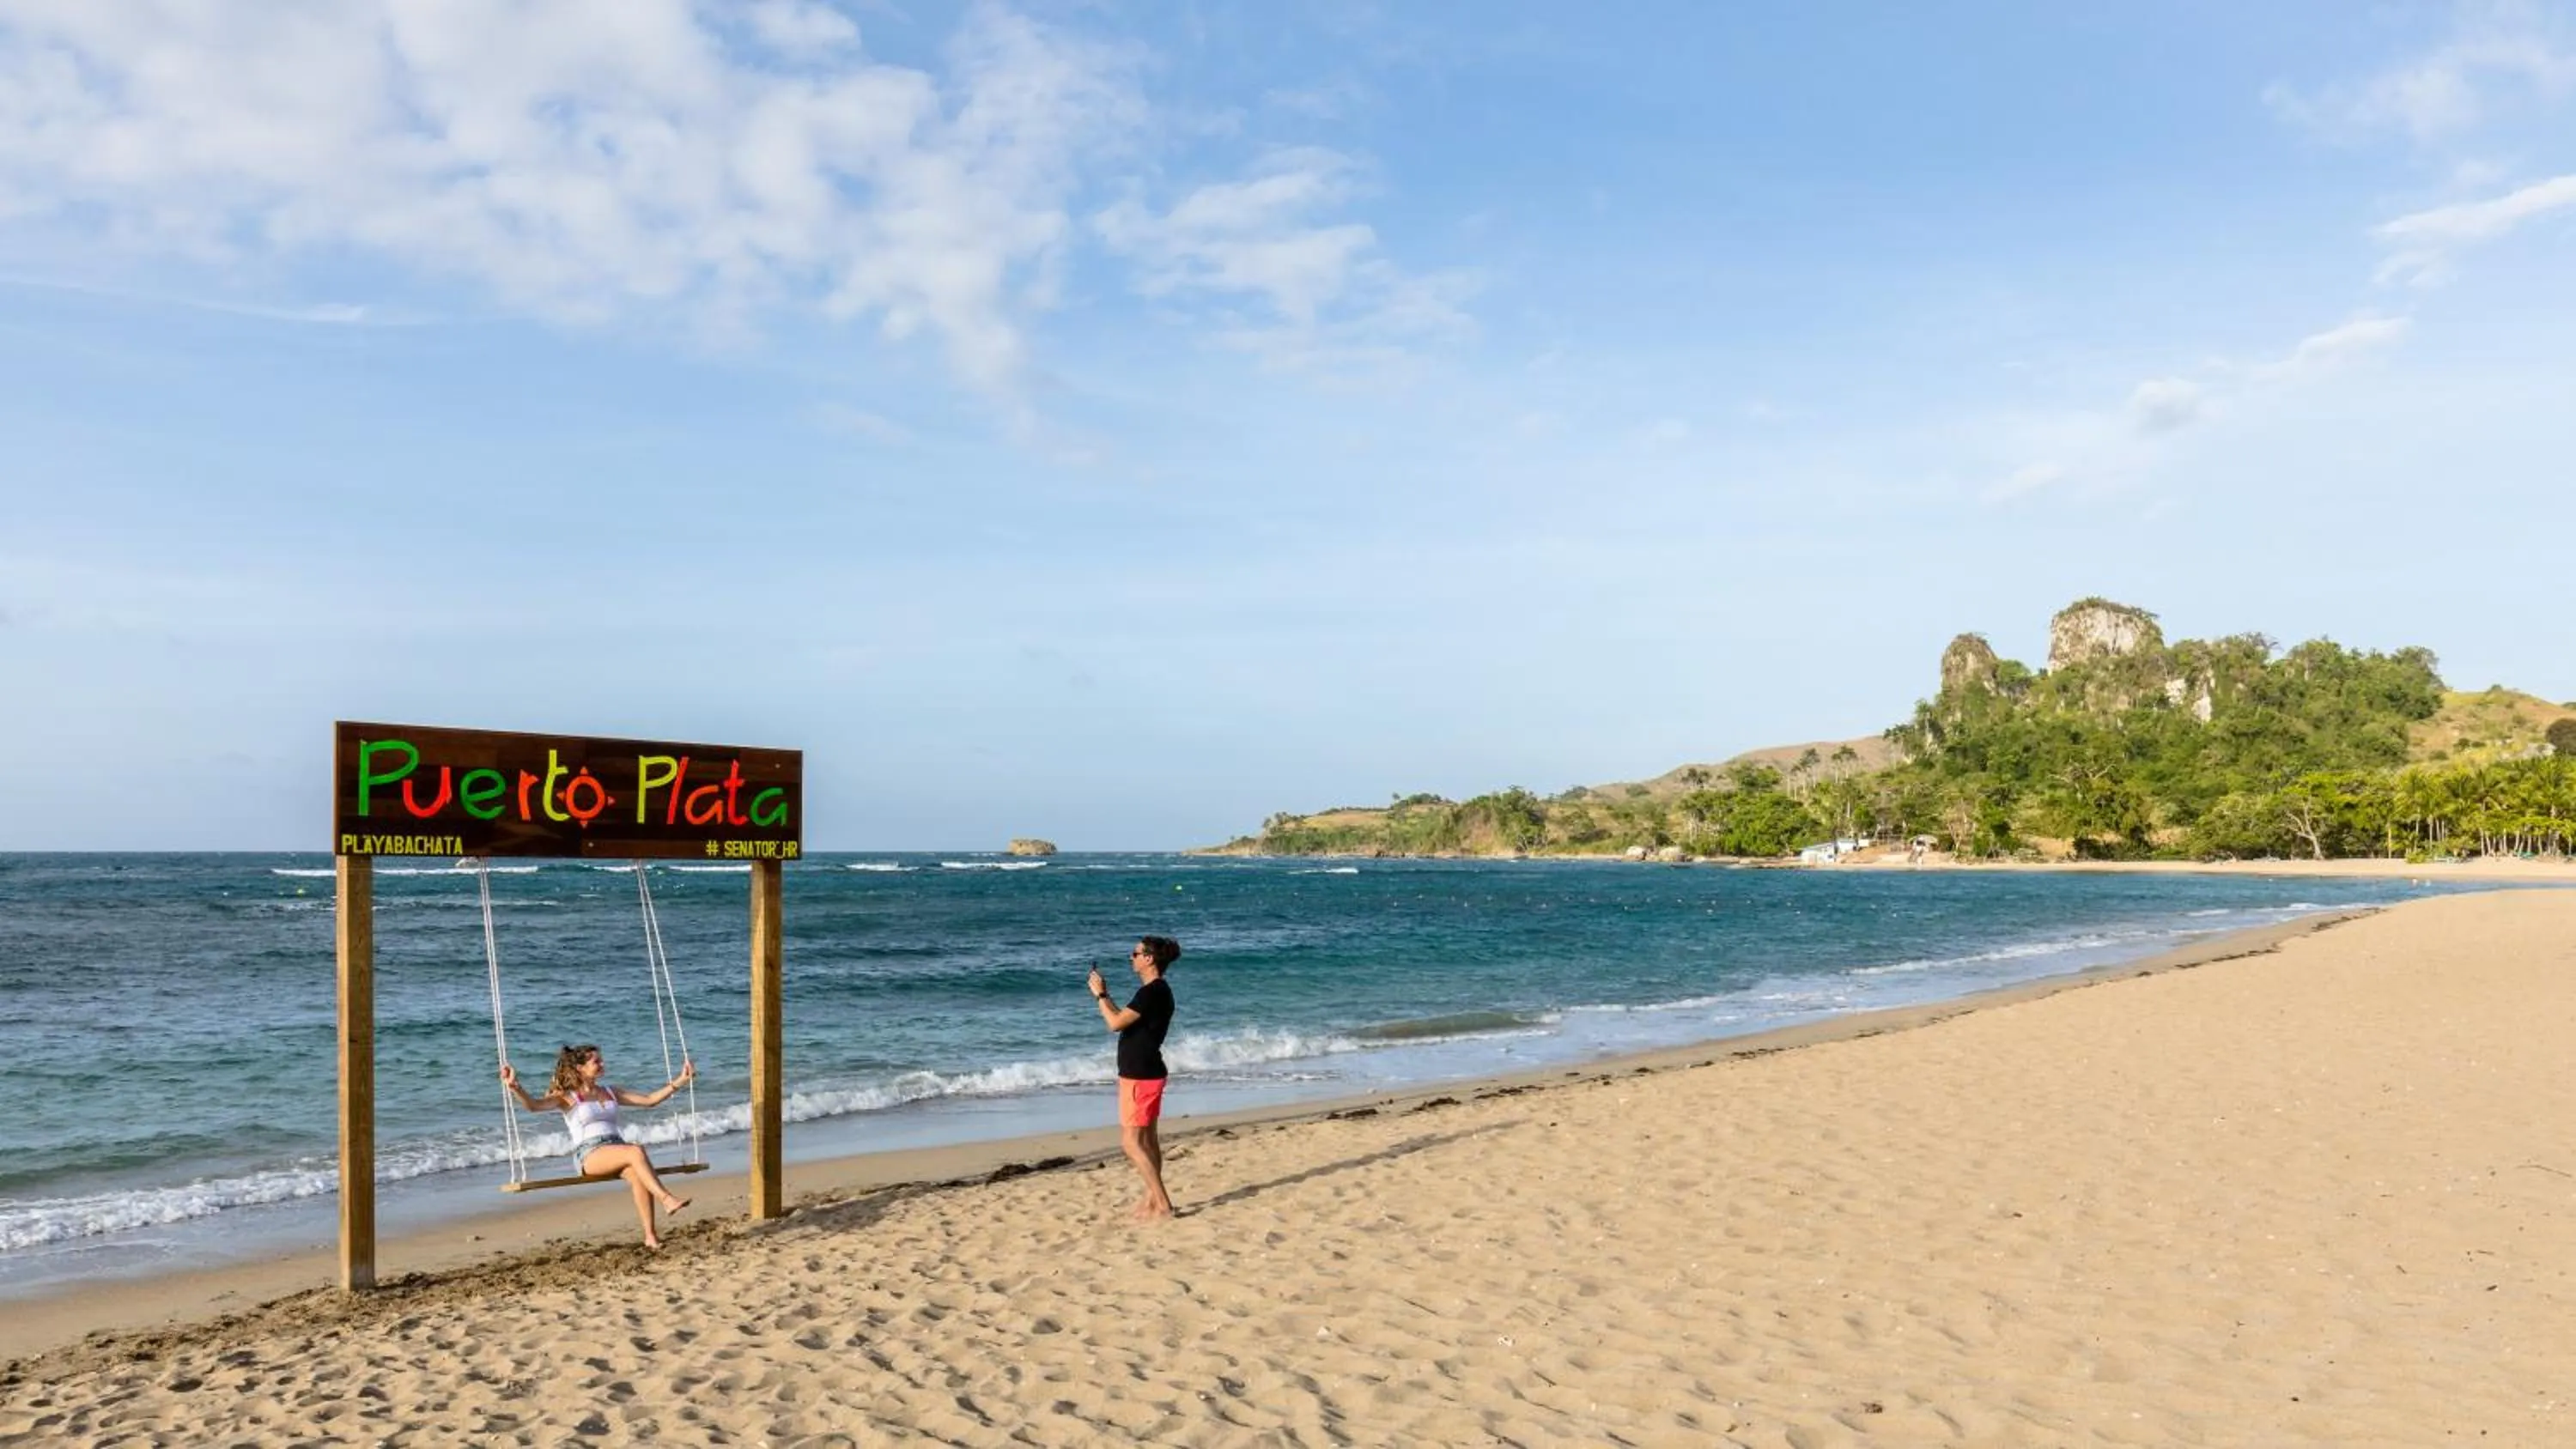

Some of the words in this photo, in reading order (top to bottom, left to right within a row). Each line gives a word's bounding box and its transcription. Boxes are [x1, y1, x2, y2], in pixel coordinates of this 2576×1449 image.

[358, 739, 609, 824] Puerto
[637, 755, 788, 826] Plata
[341, 834, 464, 854] PLAYABACHATA
